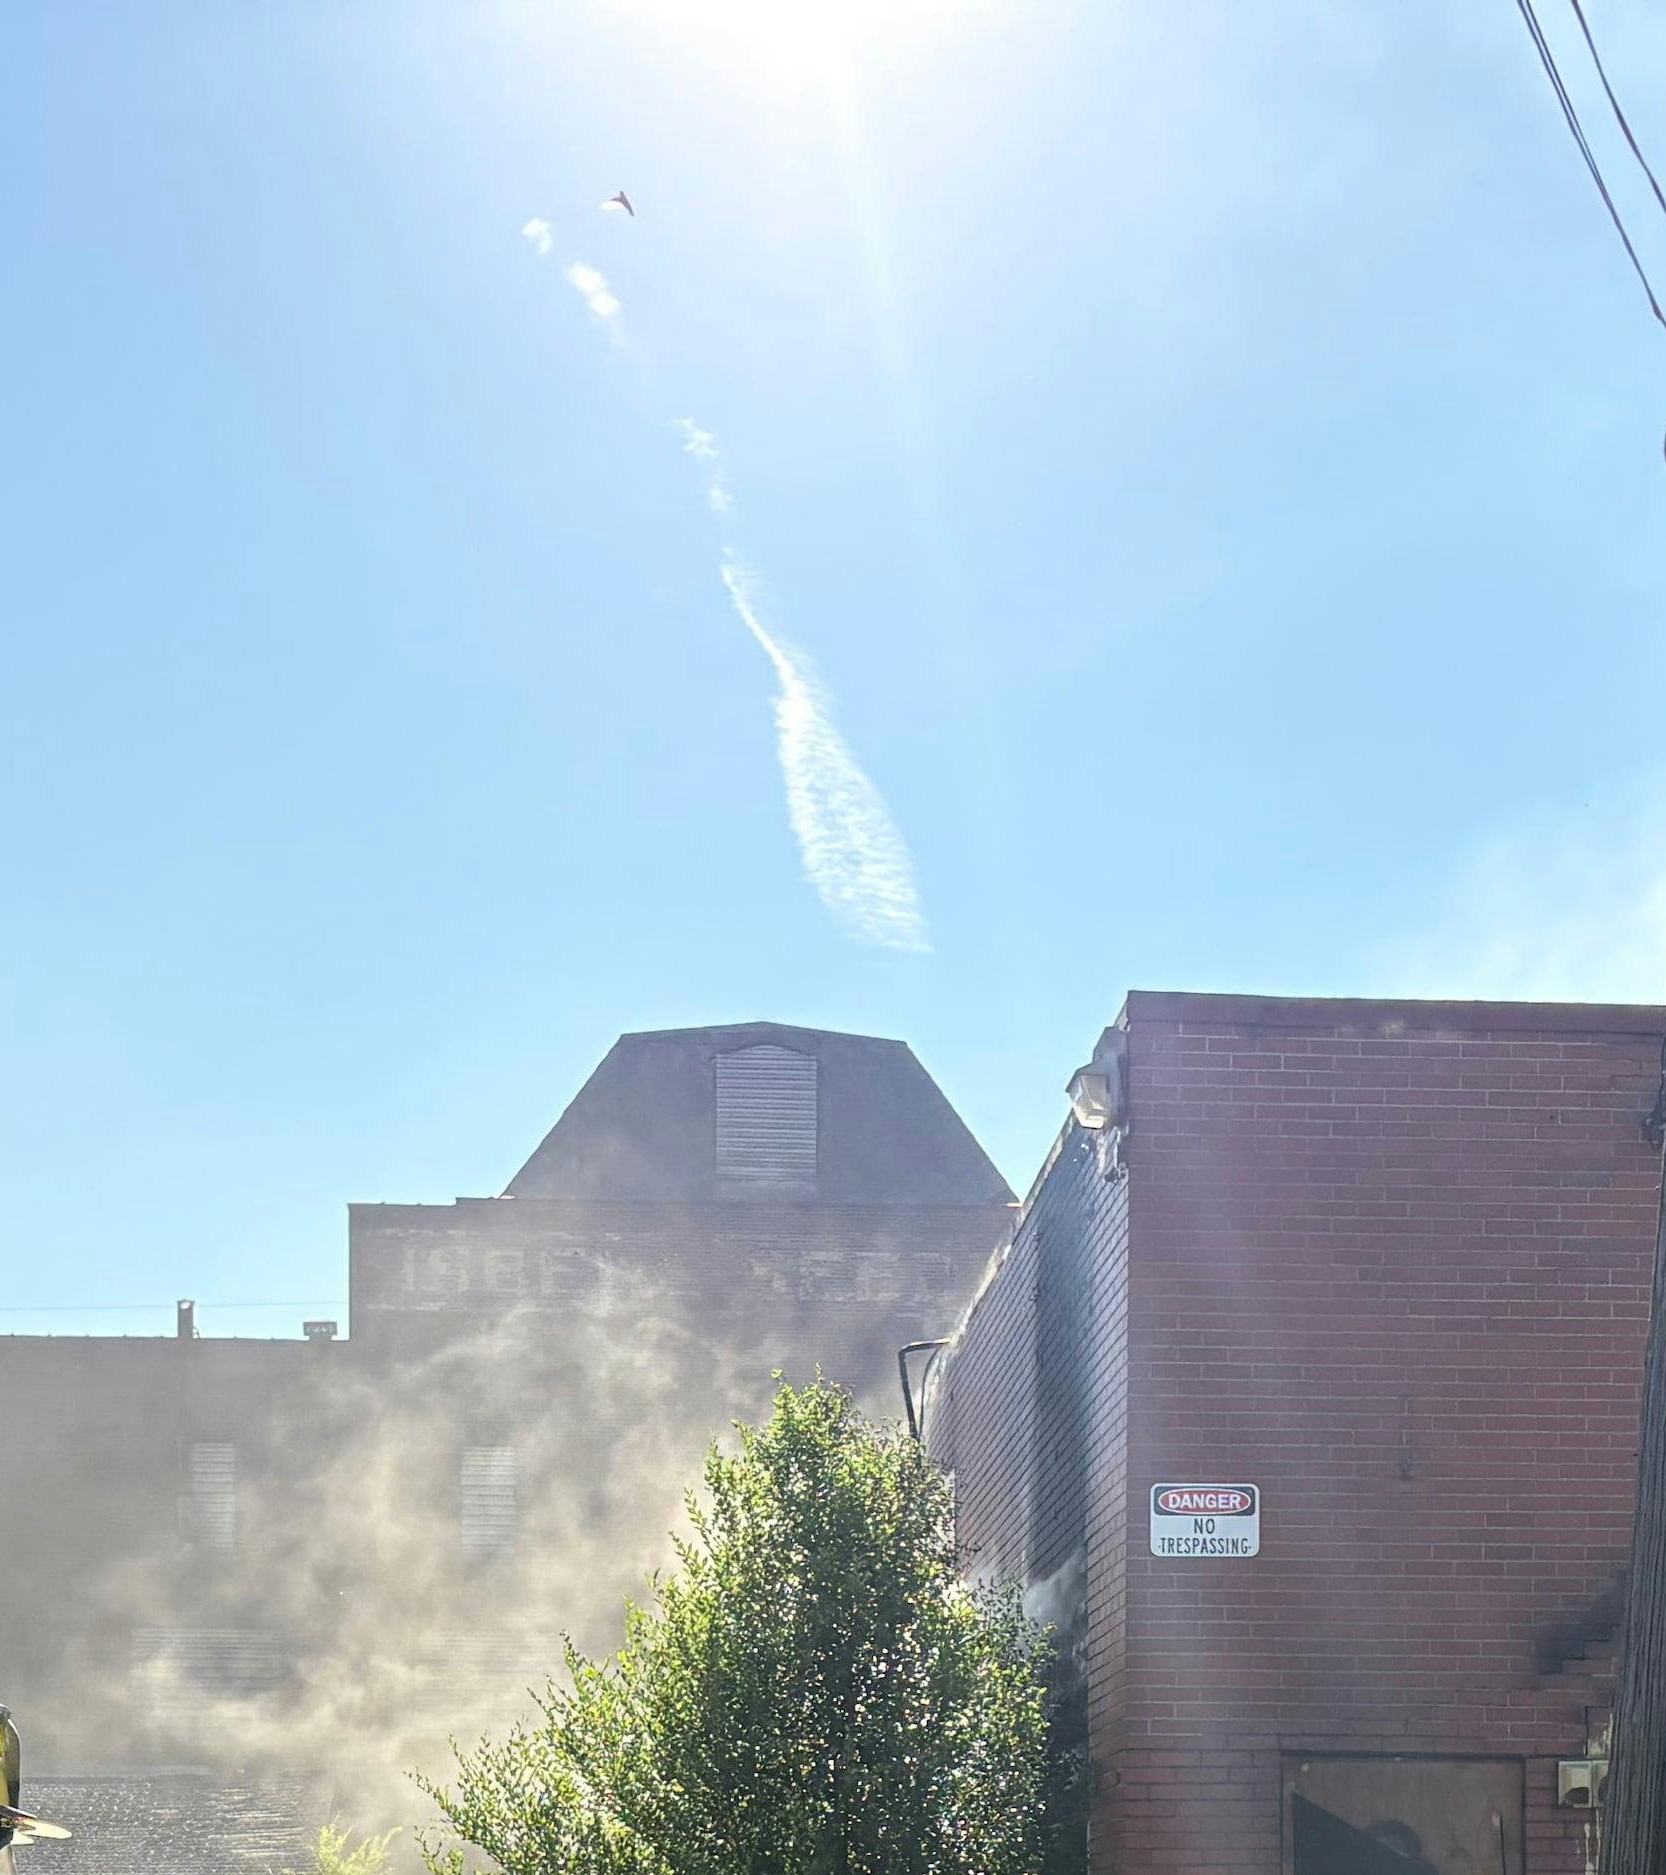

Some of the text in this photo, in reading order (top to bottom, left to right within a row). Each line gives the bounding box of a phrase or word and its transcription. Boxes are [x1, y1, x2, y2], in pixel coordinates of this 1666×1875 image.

[1168, 1493, 1241, 1509] DANGER
[1193, 1518, 1215, 1534] NO
[1159, 1537, 1249, 1555] TRESPASSING
